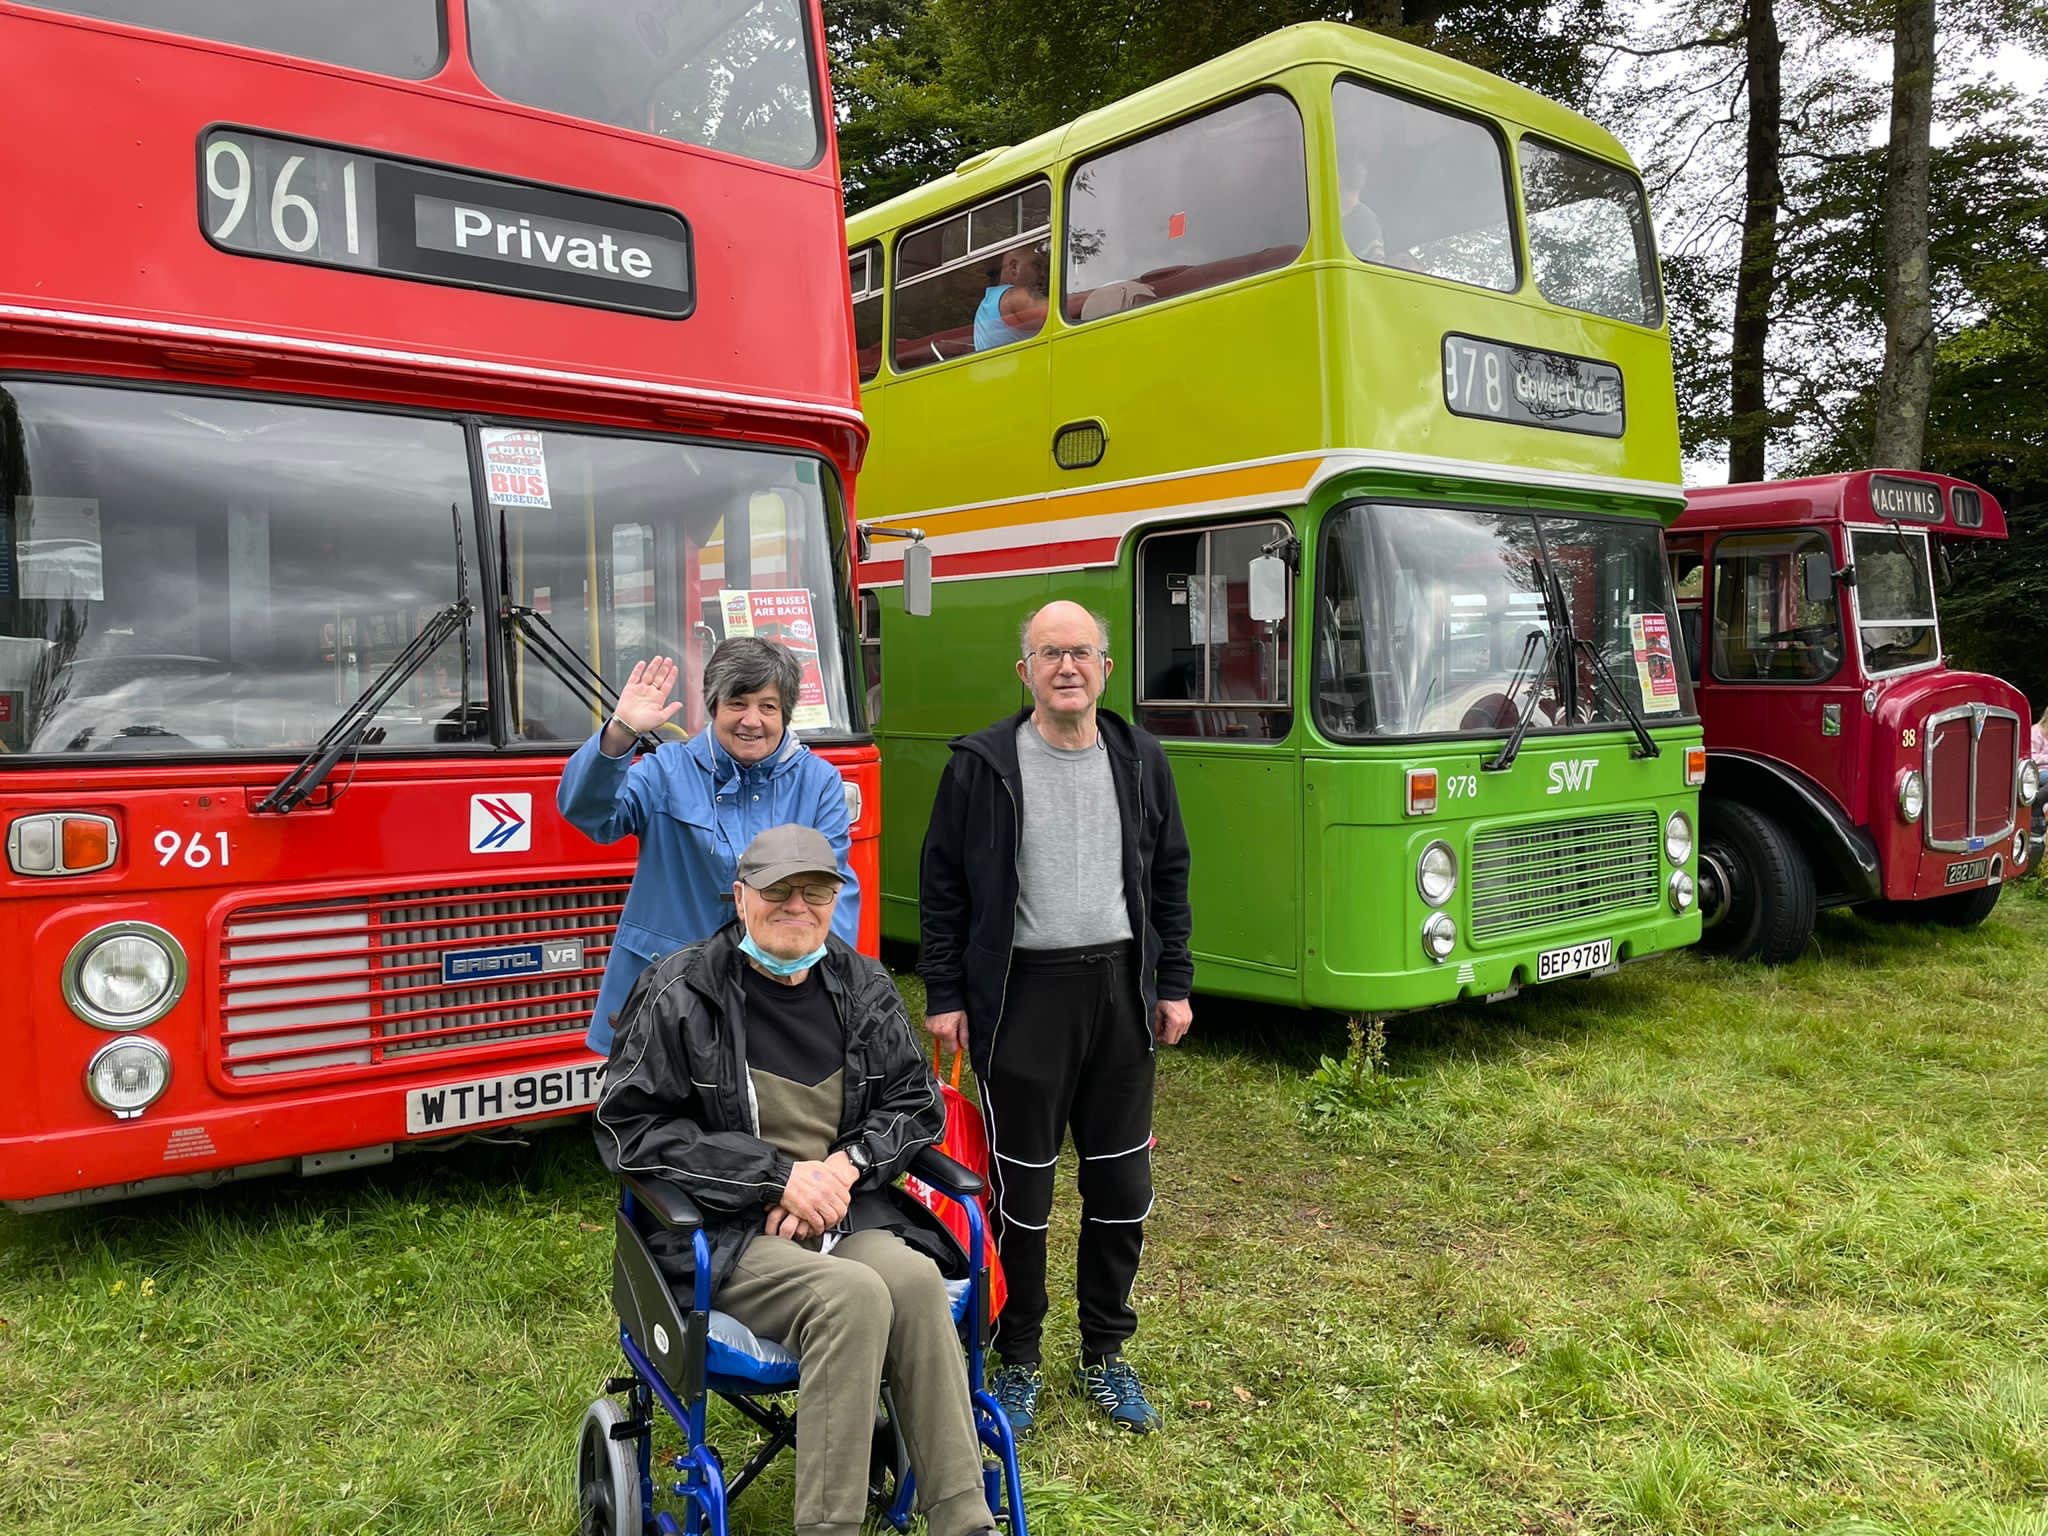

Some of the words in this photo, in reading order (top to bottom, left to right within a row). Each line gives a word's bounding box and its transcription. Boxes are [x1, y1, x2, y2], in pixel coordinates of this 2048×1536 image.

[206, 140, 359, 254] 961
[454, 207, 653, 279] Private
[489, 464, 541, 476] SWANSEA
[491, 472, 545, 497] BUS
[494, 493, 544, 505] MUSEUM
[752, 597, 774, 606] THE
[775, 595, 805, 606] BUSES
[754, 608, 776, 616] ARE
[1902, 728, 1916, 748] 38
[1447, 775, 1477, 799] 978
[1547, 759, 1599, 794] SWT
[154, 830, 229, 868] 961
[452, 953, 538, 974] BRISTOL
[547, 948, 577, 964] VR
